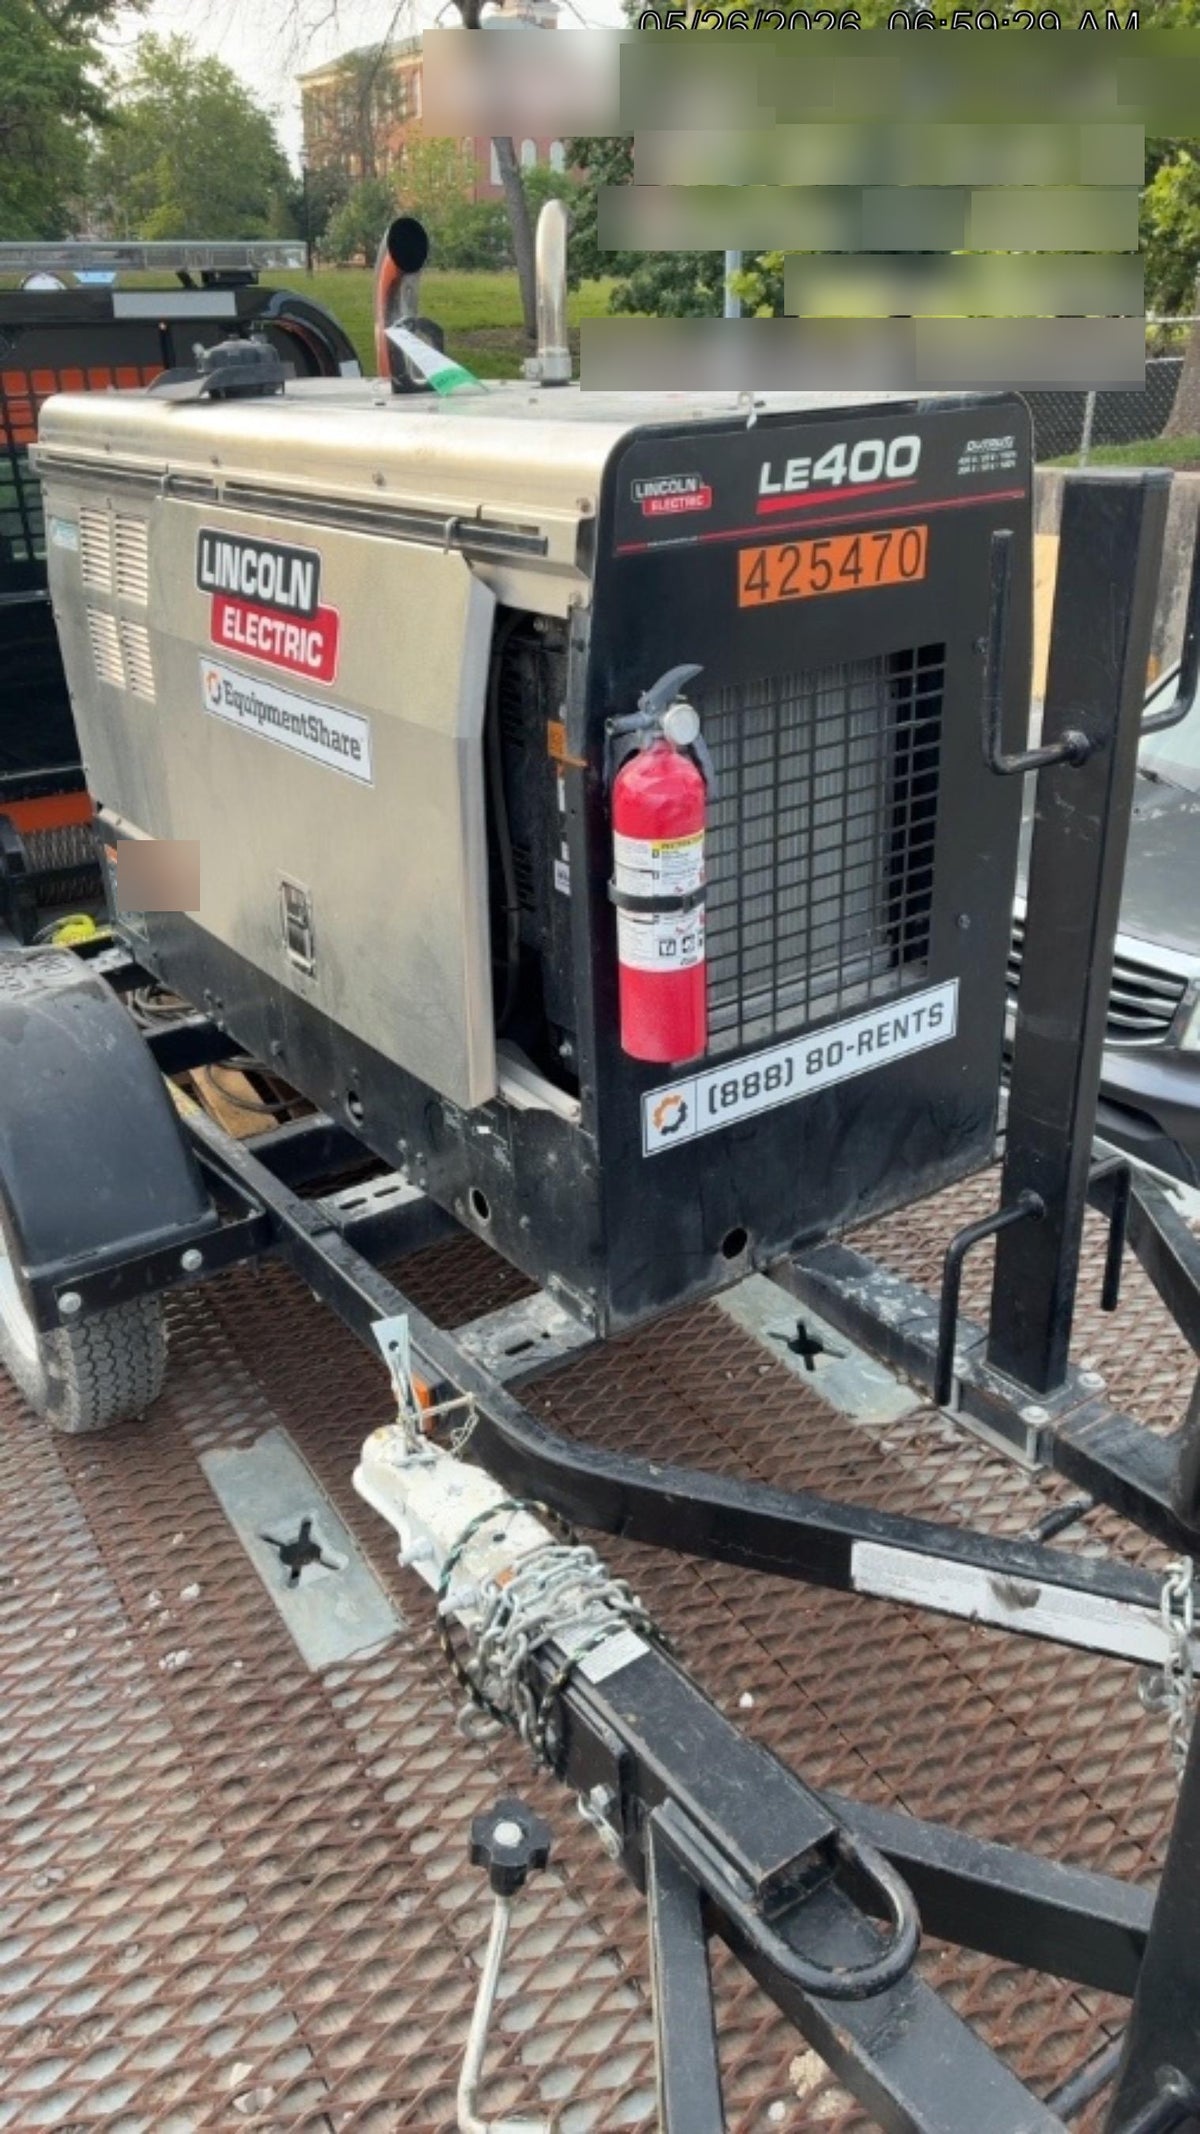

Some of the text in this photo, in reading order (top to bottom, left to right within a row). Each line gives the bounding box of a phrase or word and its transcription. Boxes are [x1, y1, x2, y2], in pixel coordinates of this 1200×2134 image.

[634, 478, 697, 498] LINCOLN
[758, 435, 921, 495] LE400
[202, 539, 313, 611] LINCOLN
[743, 528, 922, 600] 425470
[222, 605, 324, 668] ELECTRIC
[222, 680, 362, 761] EquipmentShare
[708, 1001, 944, 1115] (888) 80-RENTS
